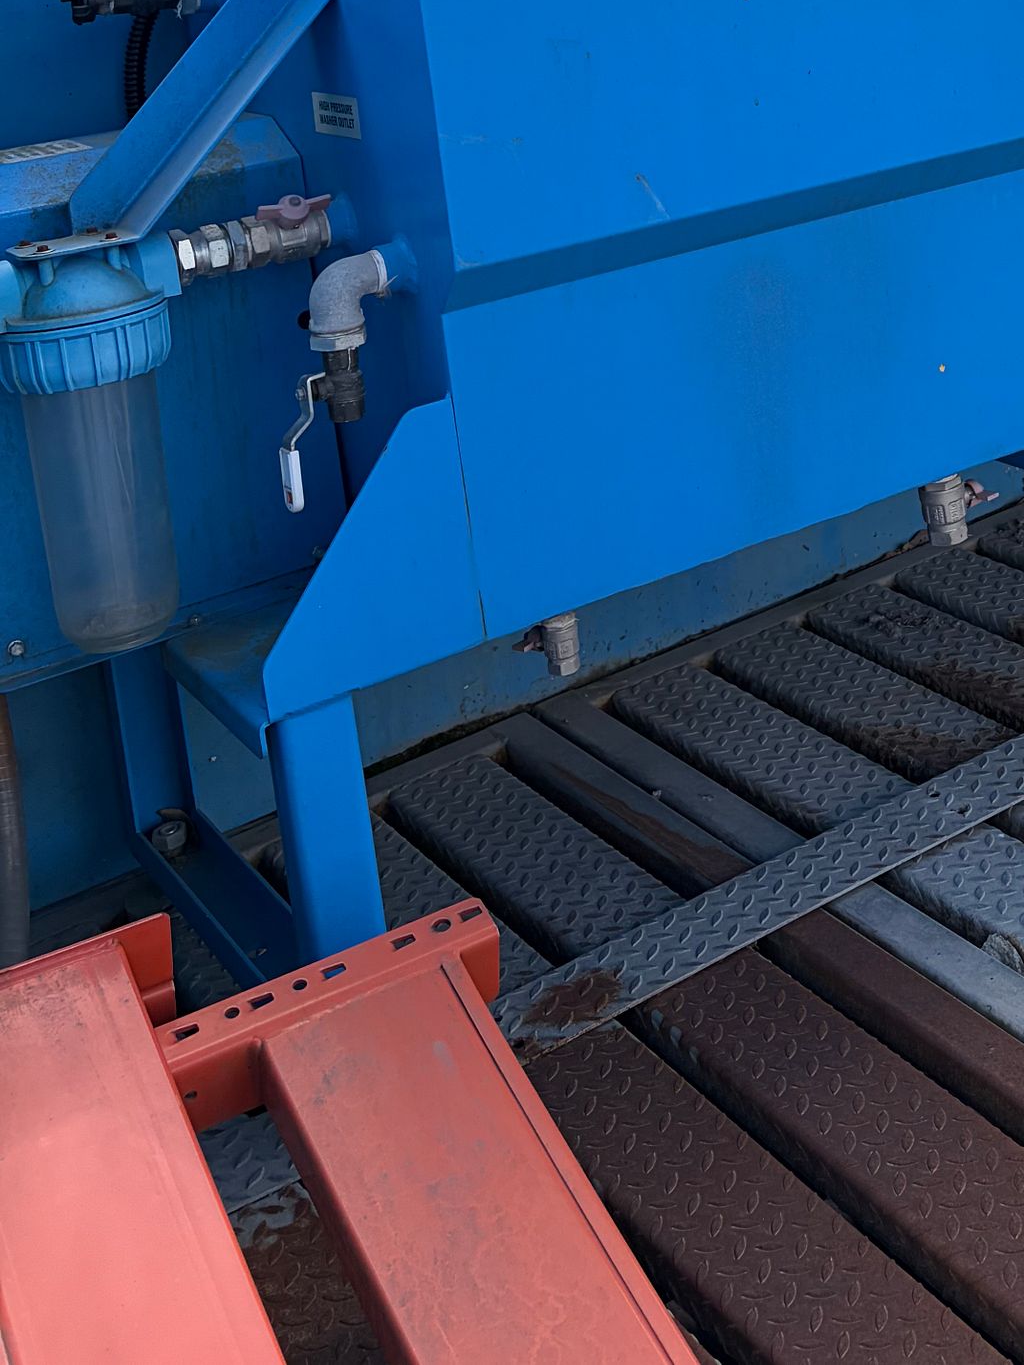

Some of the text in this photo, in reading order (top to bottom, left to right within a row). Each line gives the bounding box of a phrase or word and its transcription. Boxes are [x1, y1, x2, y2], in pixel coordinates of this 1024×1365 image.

[319, 101, 353, 115] HIGH PRESSURE
[319, 114, 354, 129] WASHER OUTLET
